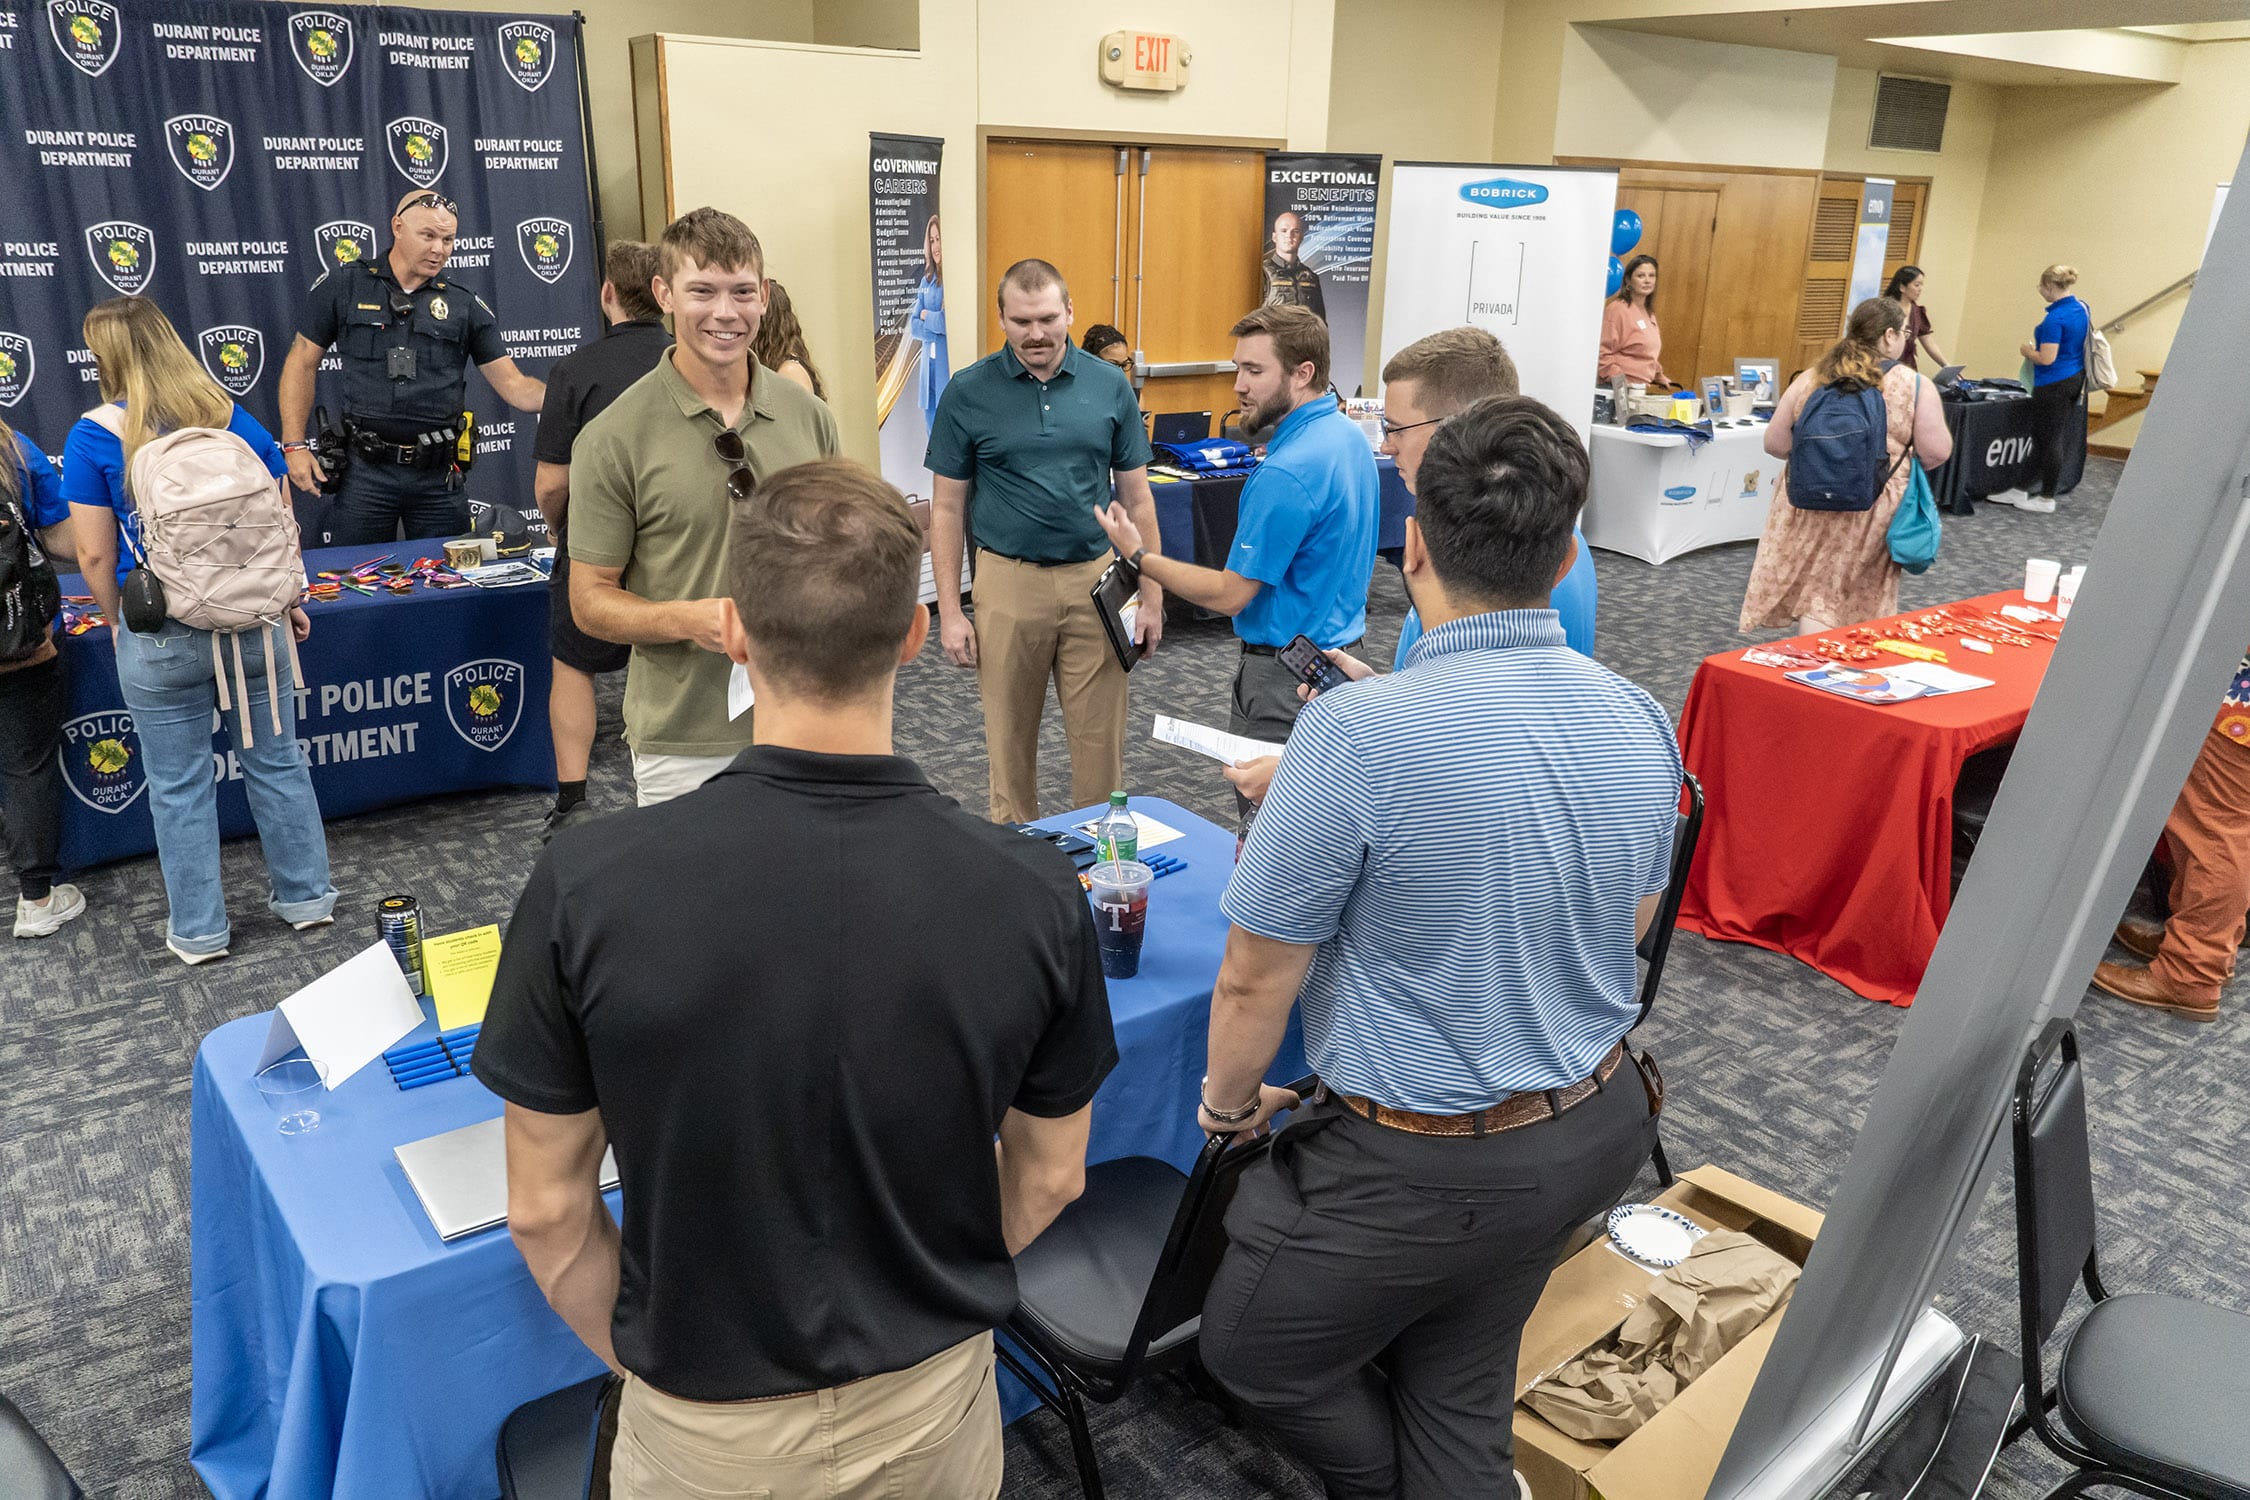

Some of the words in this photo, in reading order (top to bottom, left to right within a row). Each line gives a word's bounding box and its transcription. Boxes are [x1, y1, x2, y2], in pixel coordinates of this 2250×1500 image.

[54, 0, 112, 21] POLICE
[153, 23, 209, 40] DURANT
[212, 26, 261, 42] POLICE
[294, 16, 346, 34] POLICE
[379, 32, 430, 50] DURANT
[432, 37, 474, 51] POLICE
[504, 26, 550, 42] POLICE
[76, 52, 104, 61] DURANT
[166, 44, 256, 62] DEPARTMENT
[390, 51, 470, 70] DEPARTMENT
[1135, 36, 1170, 72] EXIT
[172, 119, 226, 137] POLICE
[393, 122, 442, 140] POLICE
[26, 130, 84, 146] DURANT
[88, 132, 137, 148] POLICE
[264, 137, 317, 152] DURANT
[319, 138, 364, 152] POLICE
[474, 139, 521, 152] DURANT
[524, 140, 562, 152] POLICE
[40, 150, 132, 168] DEPARTMENT
[276, 156, 360, 170] DEPARTMENT
[485, 157, 559, 170] DEPARTMENT
[874, 158, 938, 175] GOVERNMENT
[874, 178, 928, 194] CAREERS
[1271, 171, 1376, 185] EXCEPTIONAL
[1297, 188, 1375, 202] BENEFITS
[1470, 188, 1537, 198] BOBRICK
[1332, 204, 1374, 212] Reimbursement
[92, 226, 147, 243] POLICE
[322, 224, 370, 241] POLICE
[523, 220, 566, 236] POLICE
[4, 242, 59, 256] POLICE
[186, 242, 242, 256] DURANT
[242, 241, 288, 254] POLICE
[454, 236, 495, 250] POLICE
[876, 238, 896, 246] Clerical
[0, 262, 54, 276] RTMENT
[200, 260, 284, 275] DEPARTMENT
[1473, 302, 1513, 315] PRIVADA
[206, 329, 257, 347] POLICE
[543, 328, 582, 340] POLICE
[66, 349, 97, 364] DUR
[506, 344, 578, 358] DEPARTMENT
[224, 374, 251, 382] DURANT
[1986, 436, 2032, 468] env
[453, 665, 516, 688] POLICE
[321, 672, 432, 717] POLICE
[65, 716, 132, 744] POLIC
[471, 724, 504, 734] DURANT
[92, 781, 133, 796] DURANT
[1102, 902, 1130, 932] T
